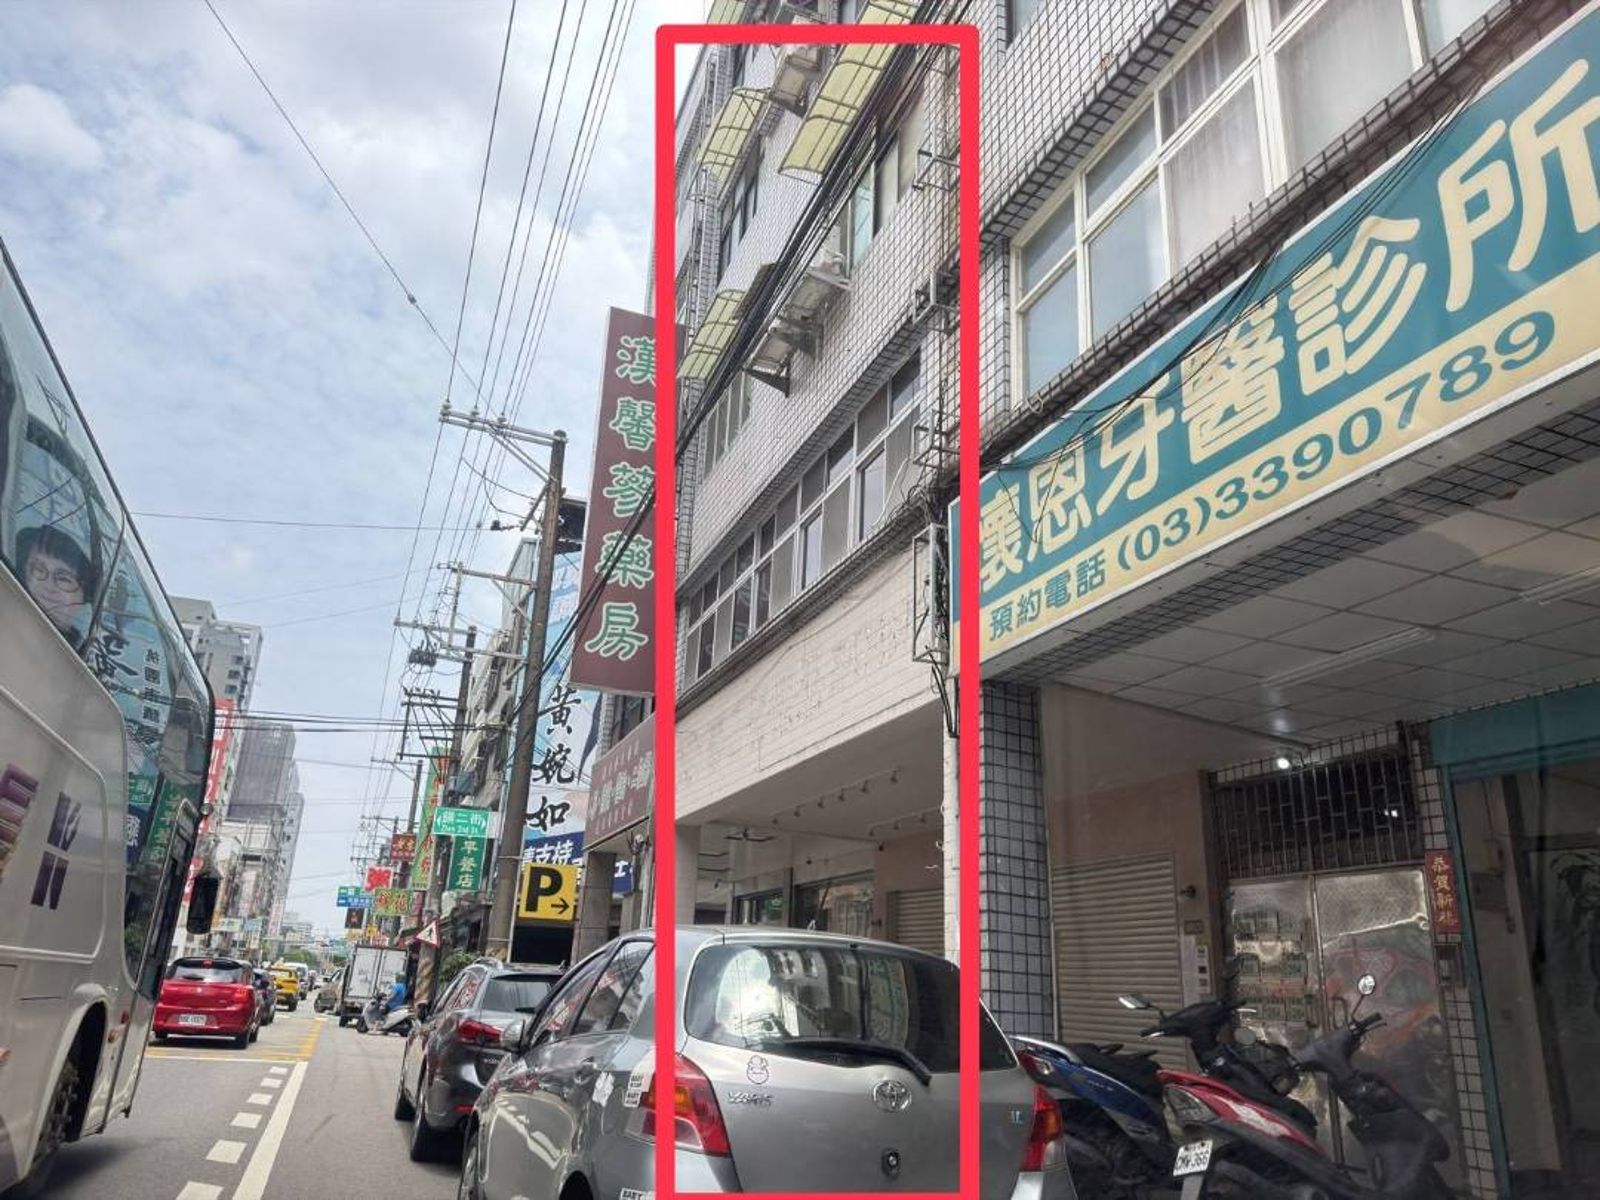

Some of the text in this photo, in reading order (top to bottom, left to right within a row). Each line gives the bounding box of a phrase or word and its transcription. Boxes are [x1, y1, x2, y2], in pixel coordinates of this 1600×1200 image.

[990, 310, 1556, 641] 預約電話 (03)3390789
[525, 866, 563, 912] P
